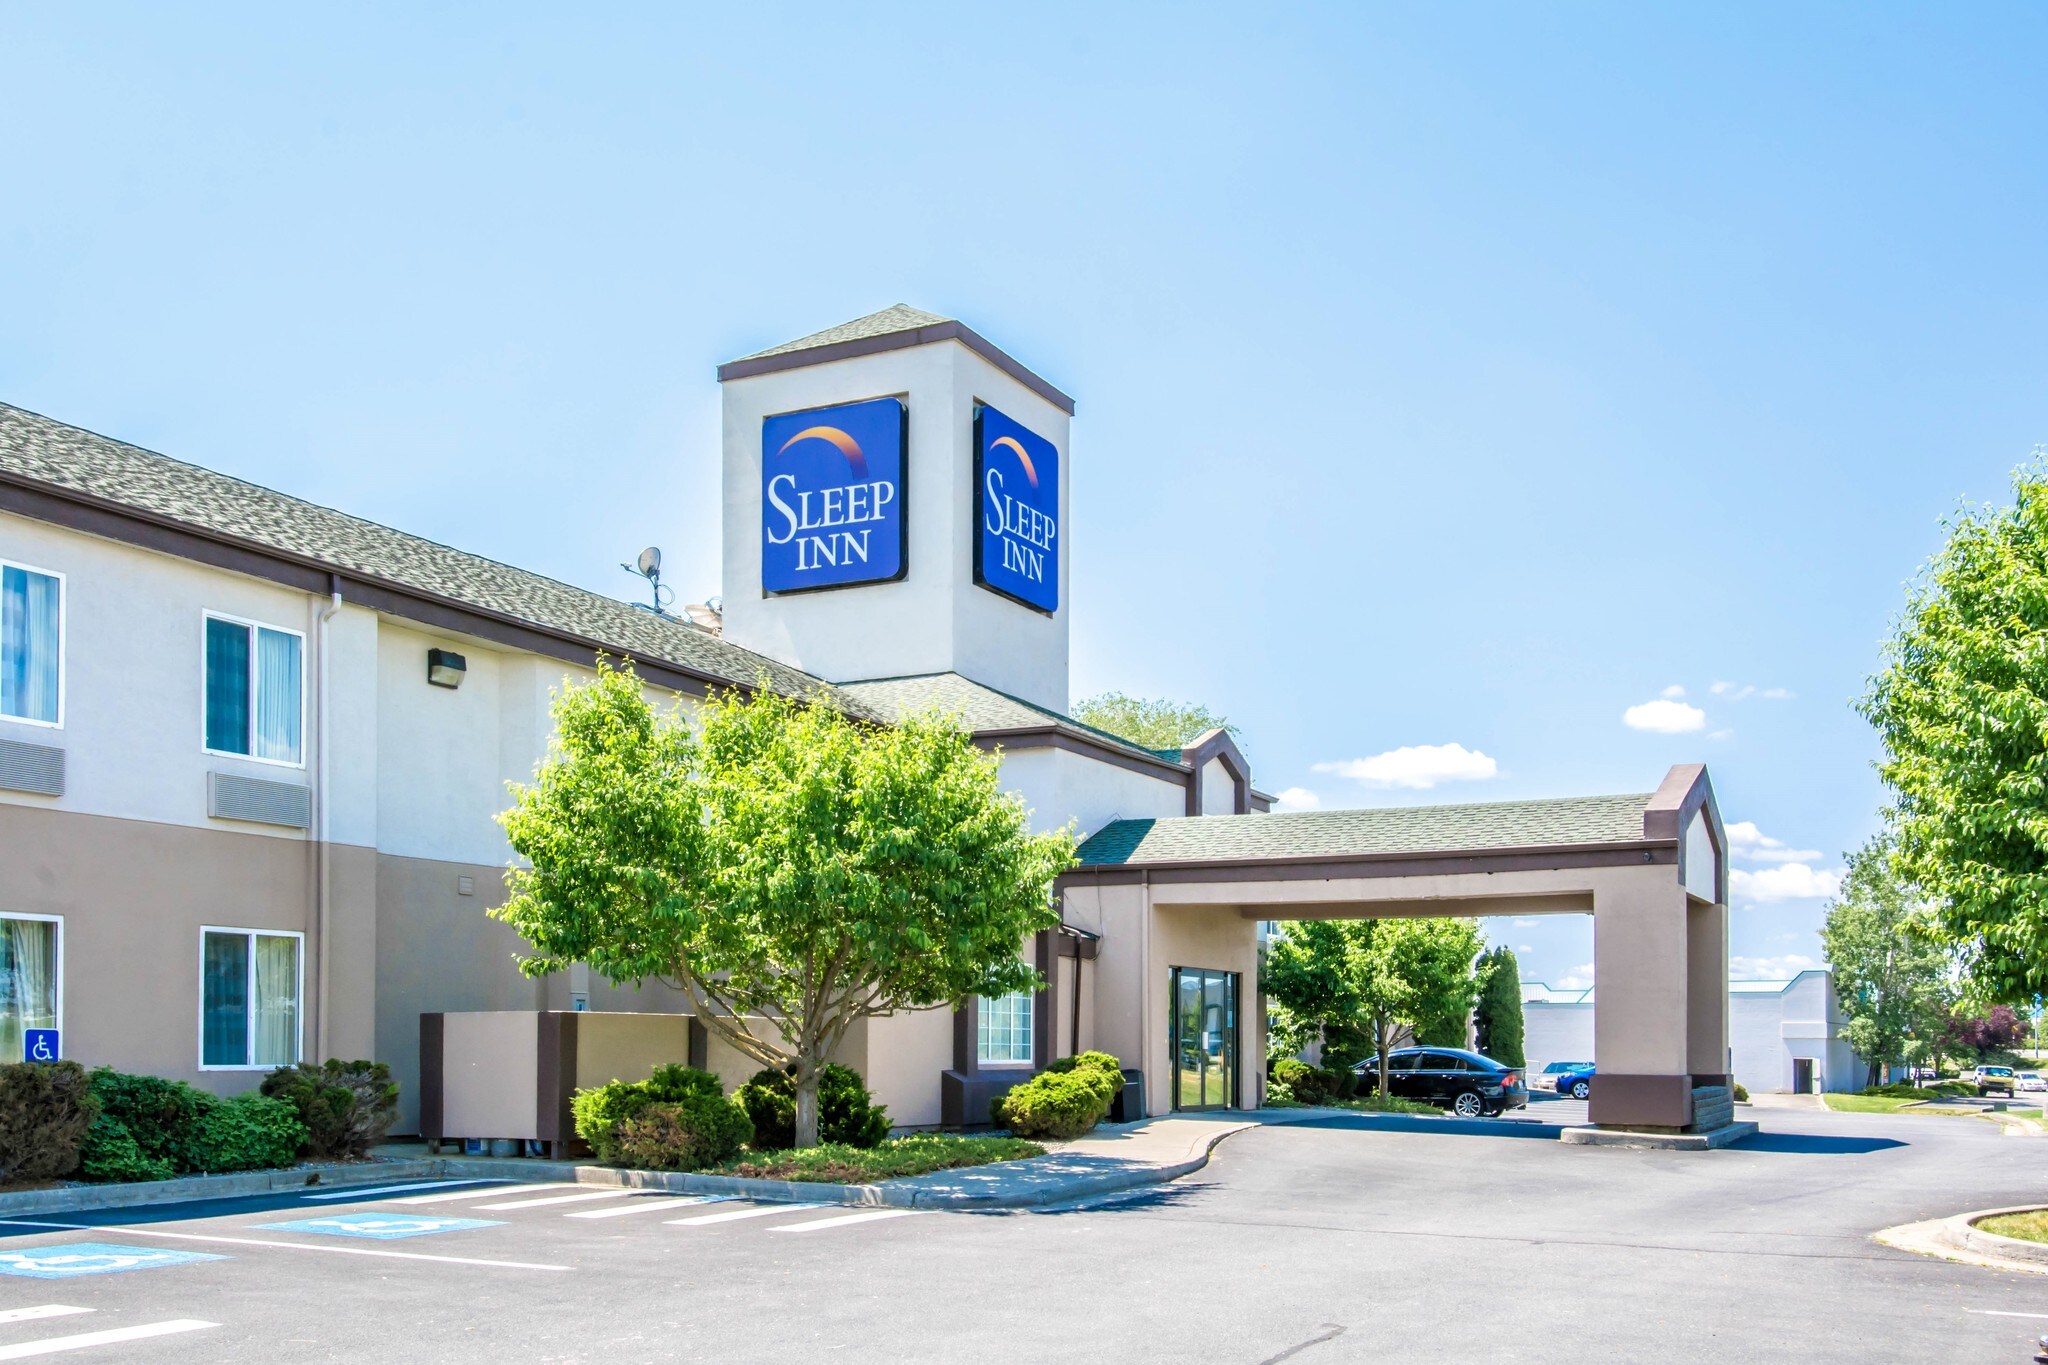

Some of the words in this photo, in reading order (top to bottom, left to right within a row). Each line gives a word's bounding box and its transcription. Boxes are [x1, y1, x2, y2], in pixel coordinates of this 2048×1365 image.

[768, 474, 894, 544] SLEEP
[986, 468, 1055, 551] SLEEP
[795, 530, 872, 571] INN
[1002, 536, 1044, 584] INN
